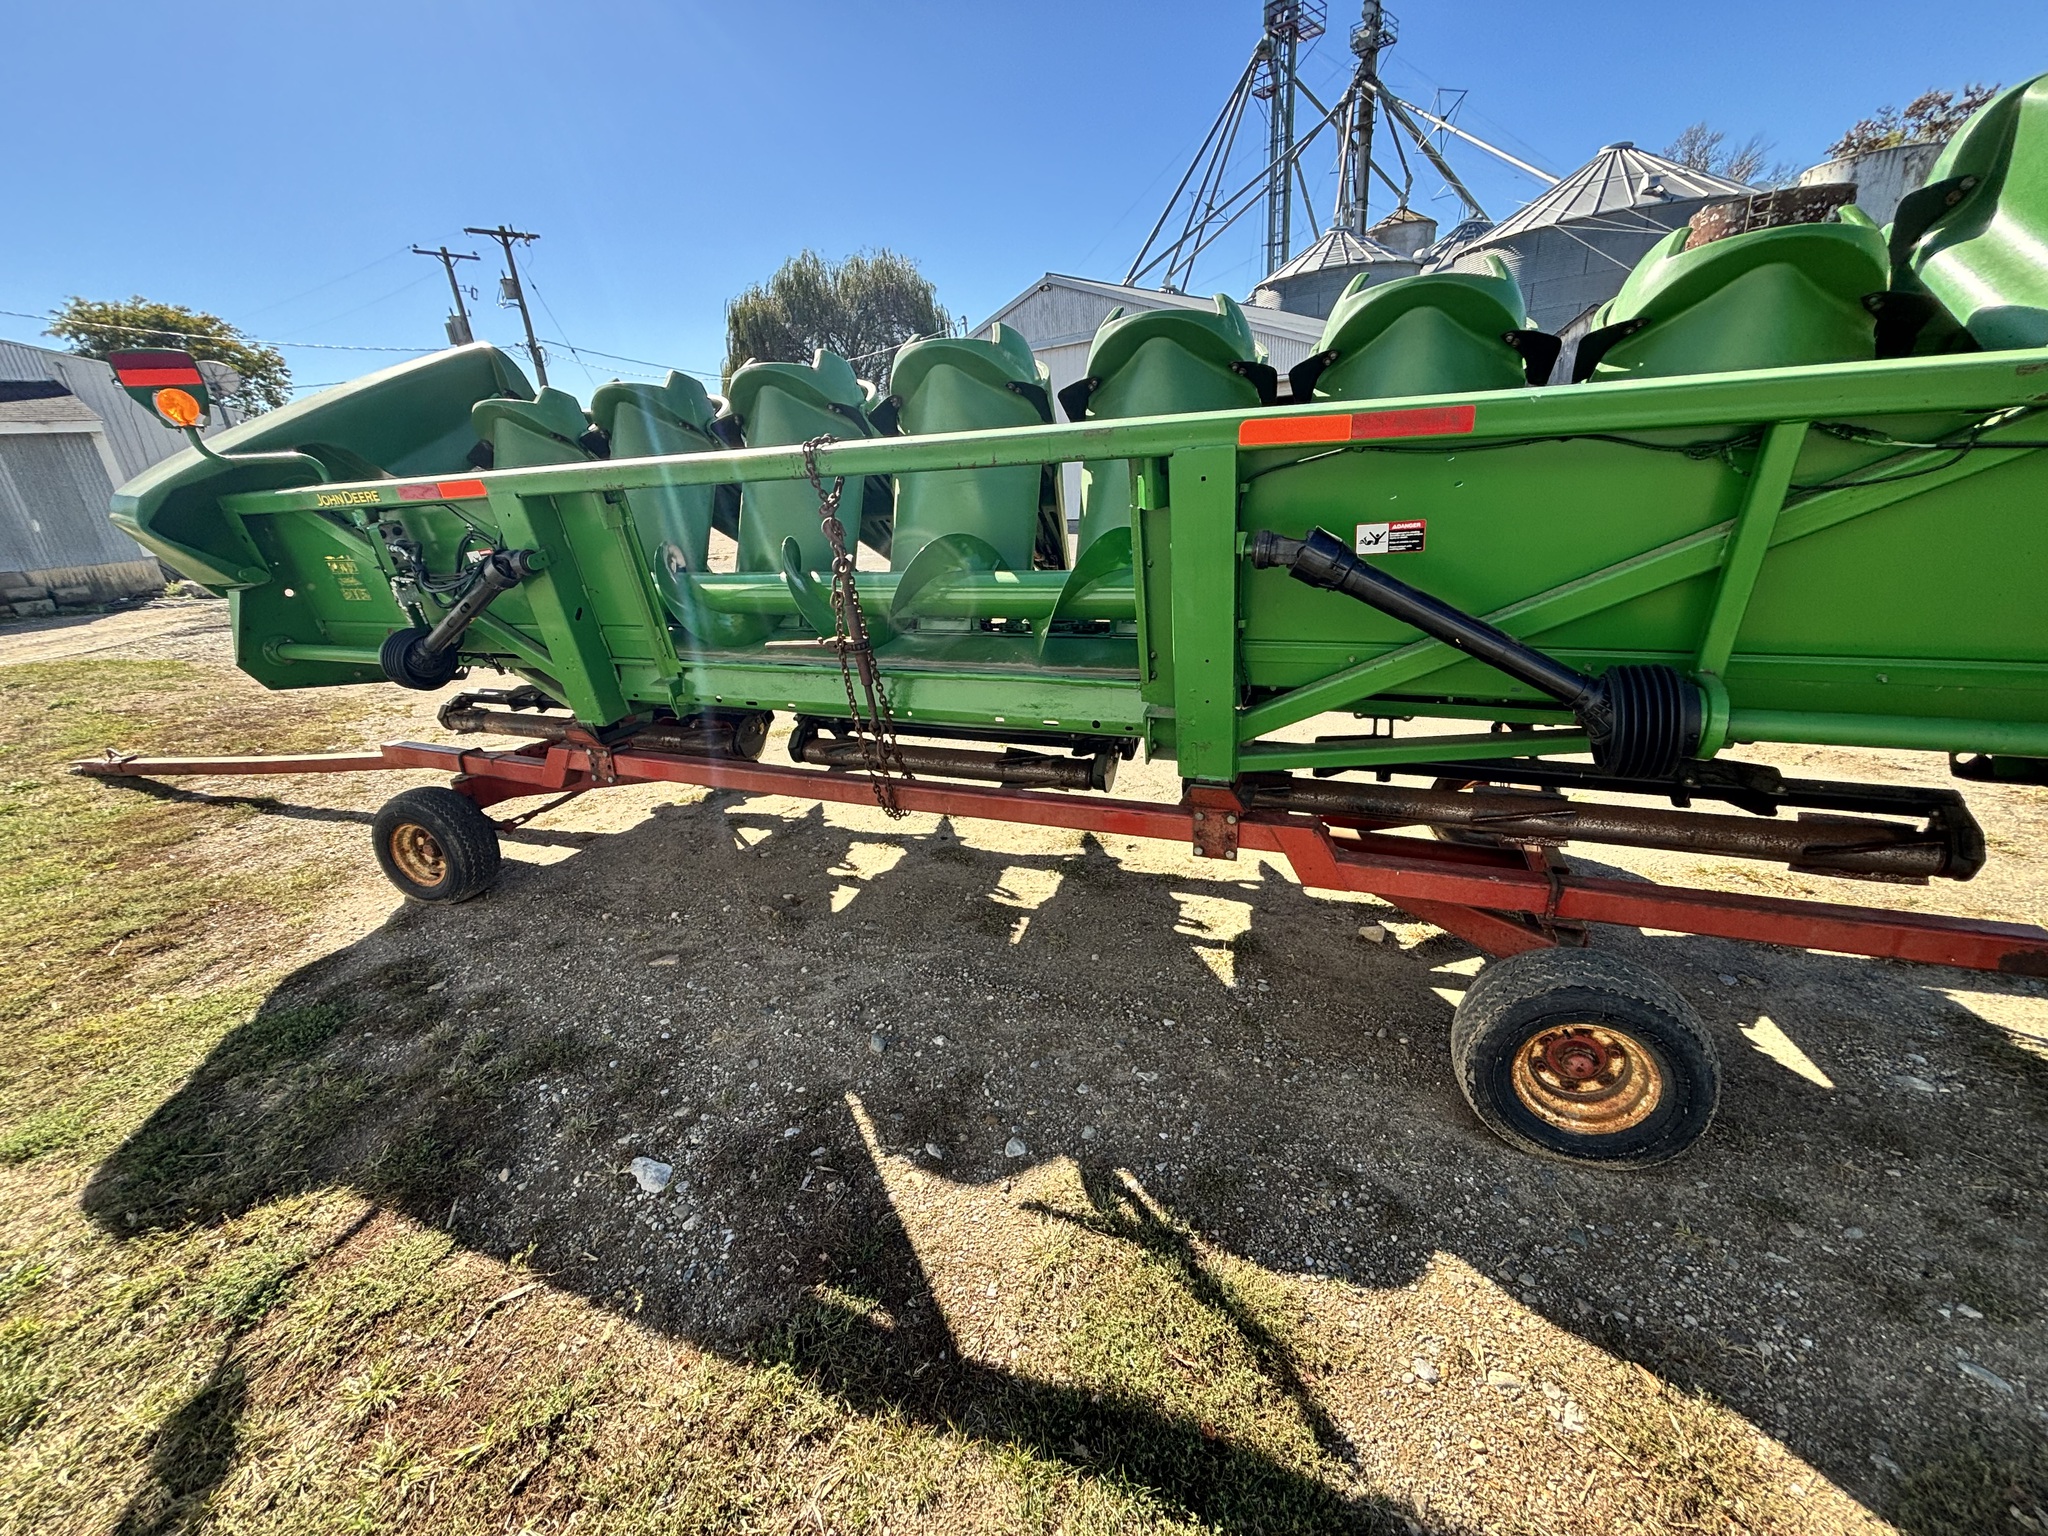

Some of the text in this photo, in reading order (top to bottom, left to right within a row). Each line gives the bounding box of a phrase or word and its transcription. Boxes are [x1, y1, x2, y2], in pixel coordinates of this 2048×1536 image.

[316, 490, 381, 507] JOHN DEERE
[1397, 522, 1422, 530] DANGER
